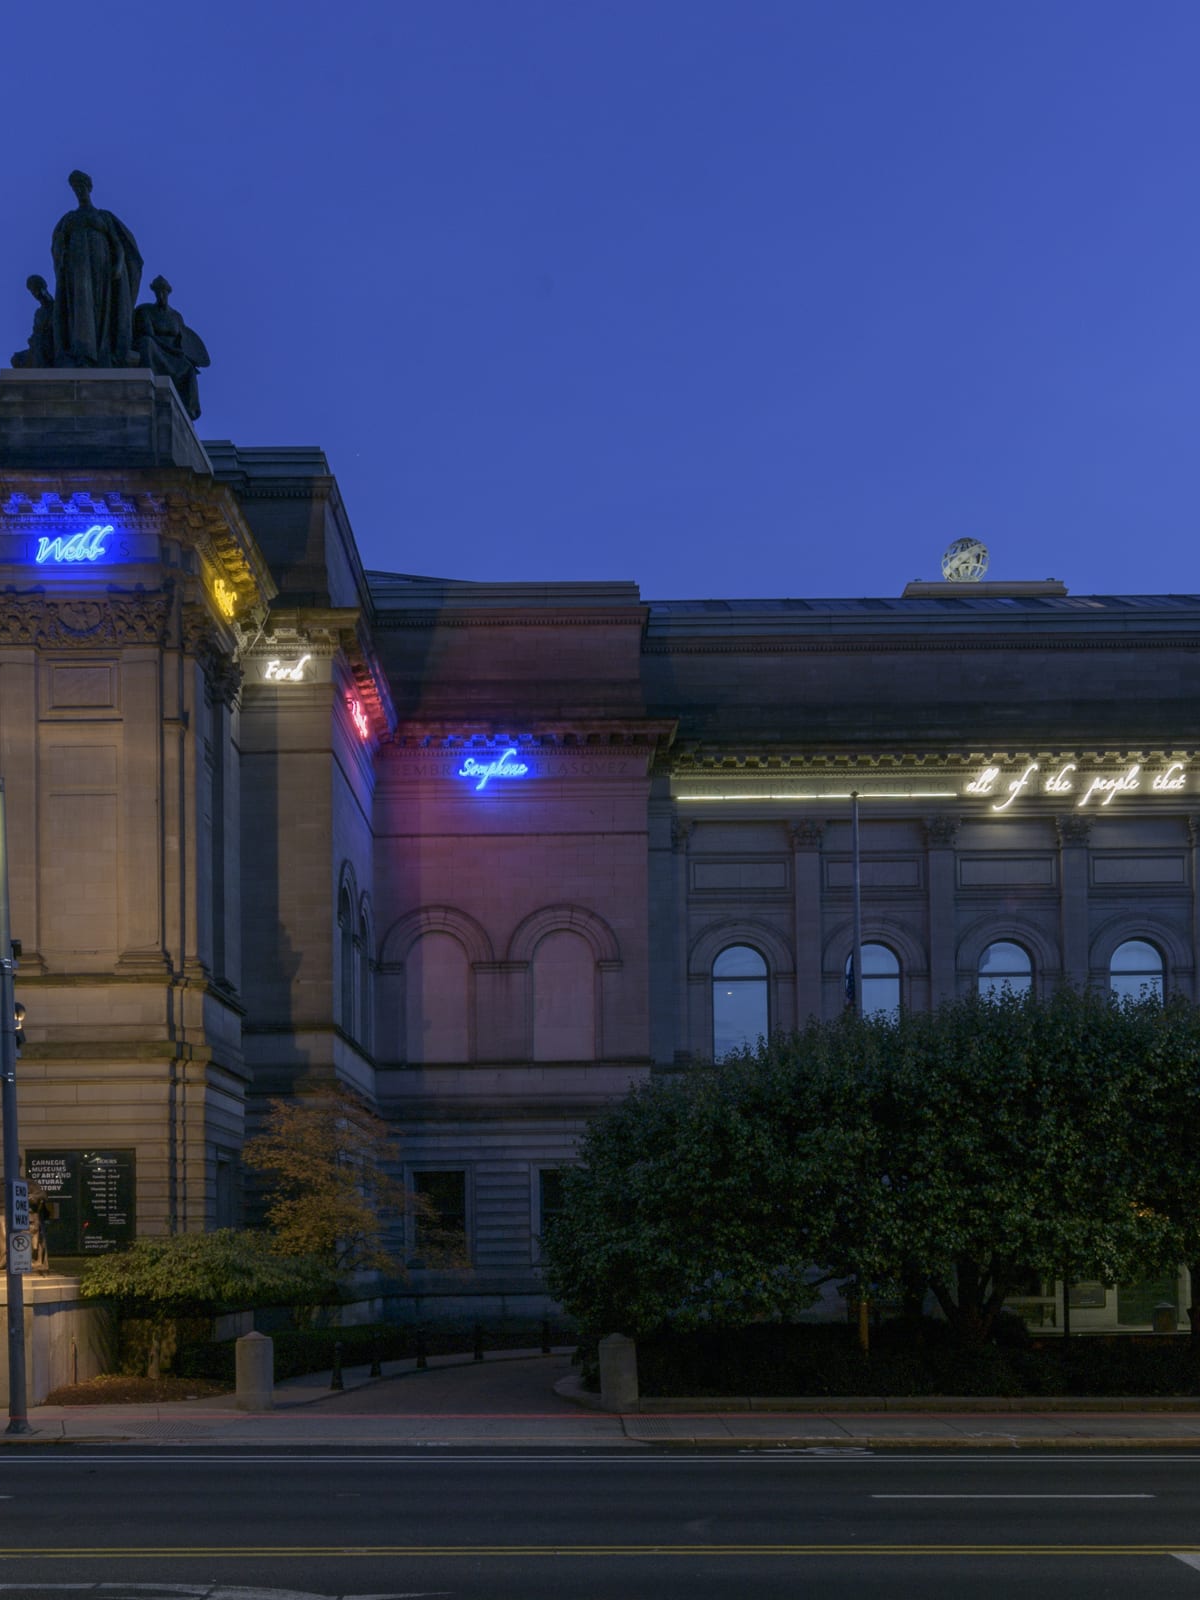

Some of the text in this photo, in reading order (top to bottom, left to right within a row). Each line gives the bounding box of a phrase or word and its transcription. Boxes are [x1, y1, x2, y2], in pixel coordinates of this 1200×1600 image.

[36, 525, 114, 564] Webb
[265, 654, 311, 681] Ford
[391, 763, 450, 776] REMBR
[966, 763, 1186, 810] all of the people that
[15, 1185, 27, 1197] END
[16, 1200, 28, 1211] ONE
[15, 1215, 28, 1226] WAY
